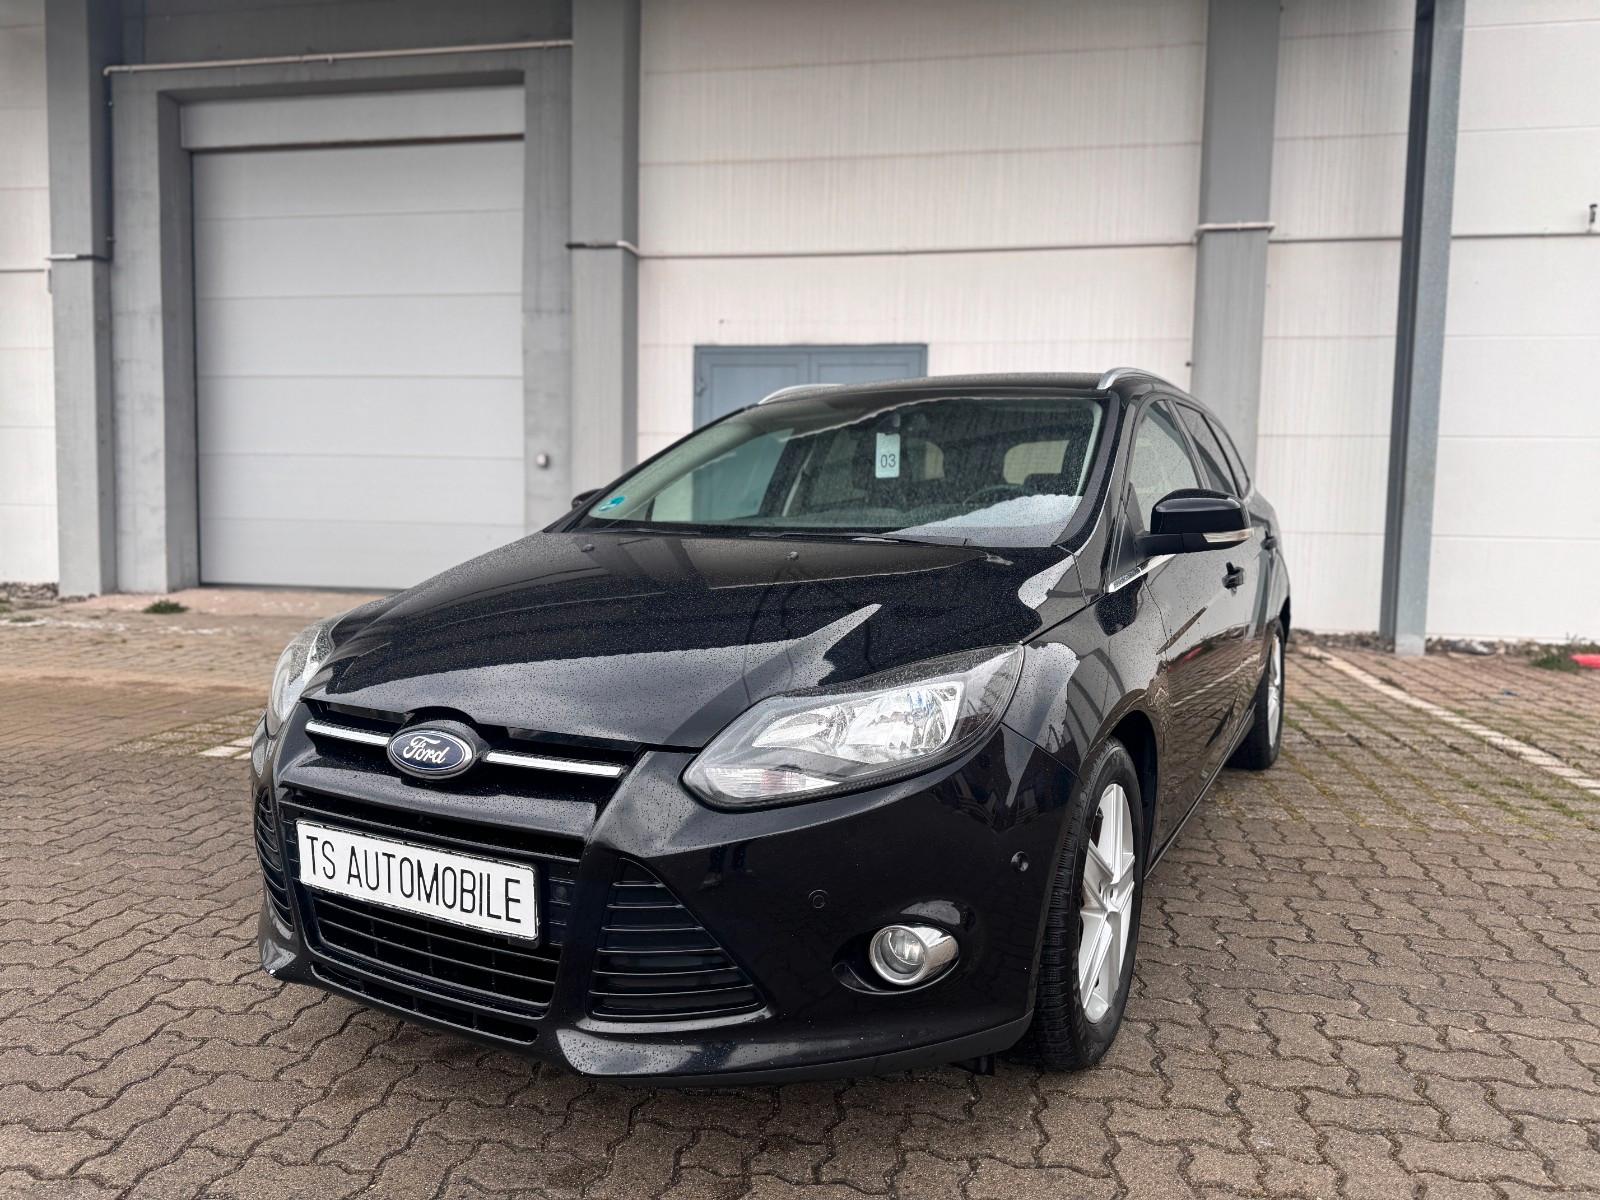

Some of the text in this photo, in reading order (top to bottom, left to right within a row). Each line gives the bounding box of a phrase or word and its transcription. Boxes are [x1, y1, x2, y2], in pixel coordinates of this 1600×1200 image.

[880, 453, 896, 468] 03
[402, 736, 449, 764] Ford
[306, 835, 522, 924] TS AUTOMOBILE
